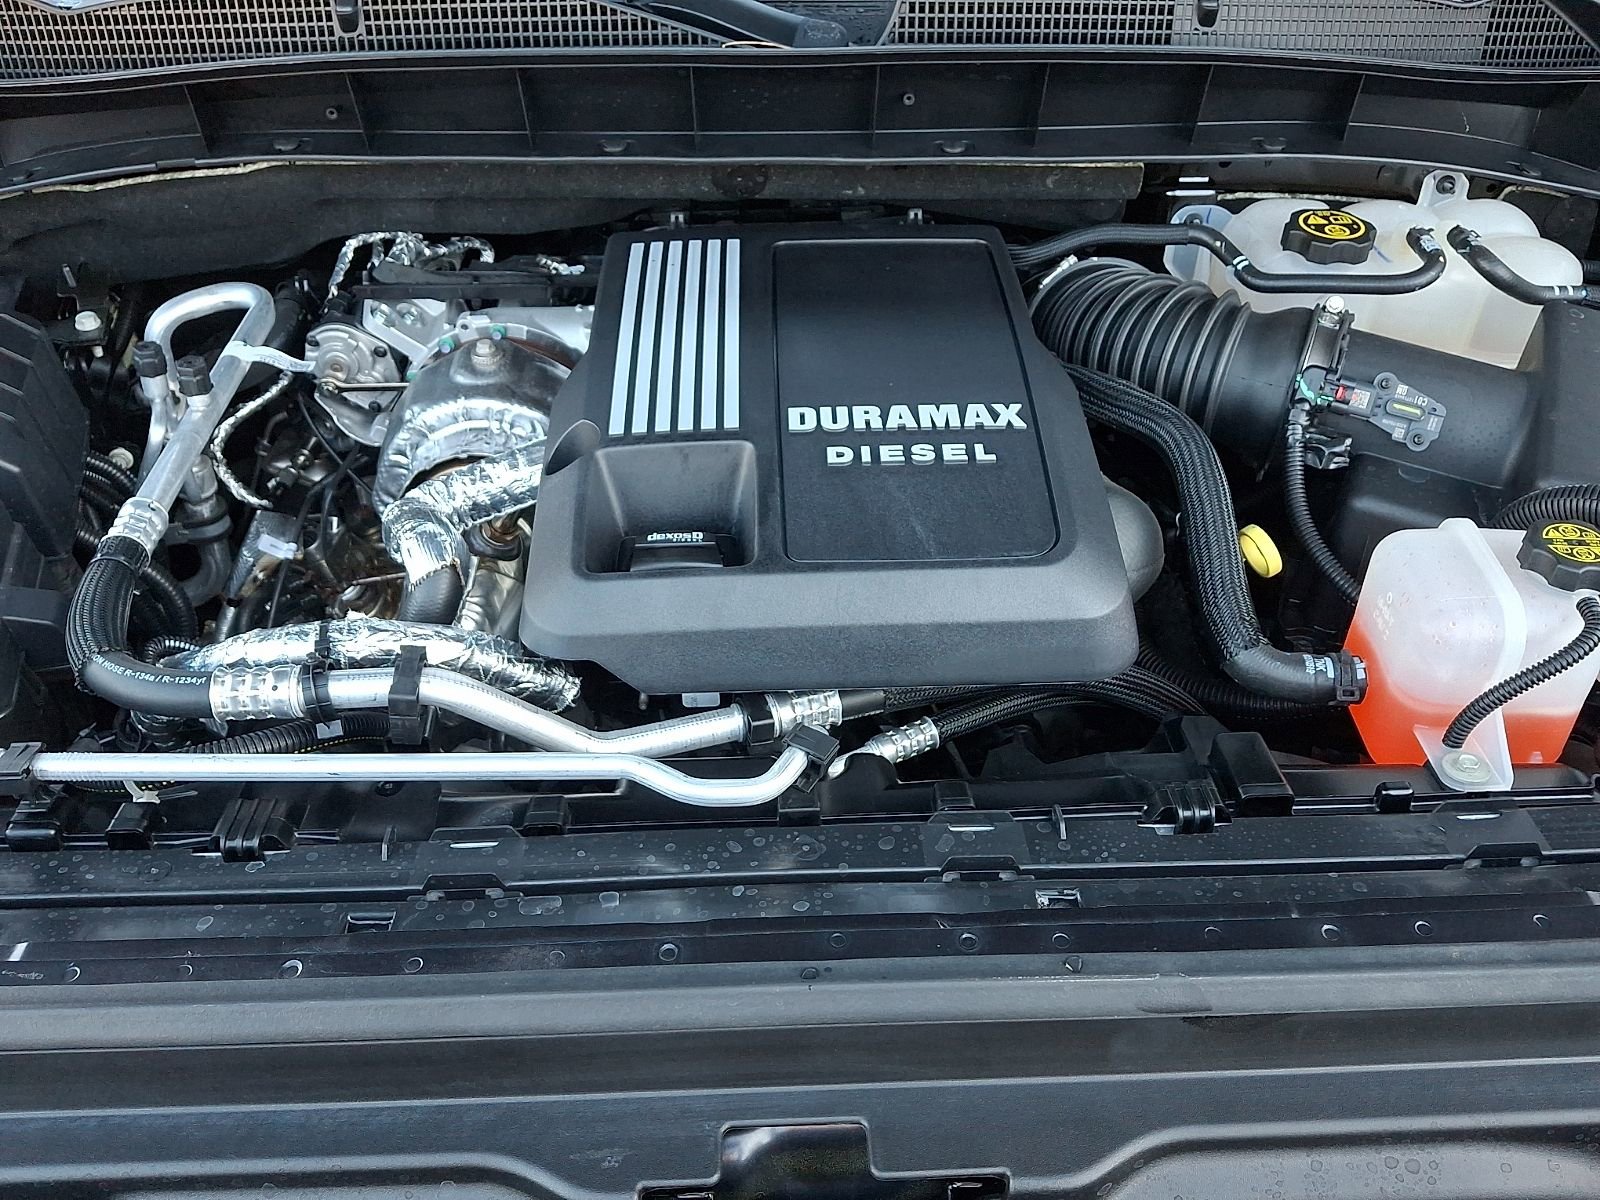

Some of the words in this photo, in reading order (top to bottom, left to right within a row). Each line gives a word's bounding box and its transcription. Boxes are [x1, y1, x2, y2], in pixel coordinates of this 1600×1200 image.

[787, 403, 1028, 433] DURAMAX
[826, 443, 997, 467] DIESEL
[101, 660, 125, 675] HOSE
[124, 668, 155, 682] R-134a
[162, 675, 207, 686] R-1234yf
